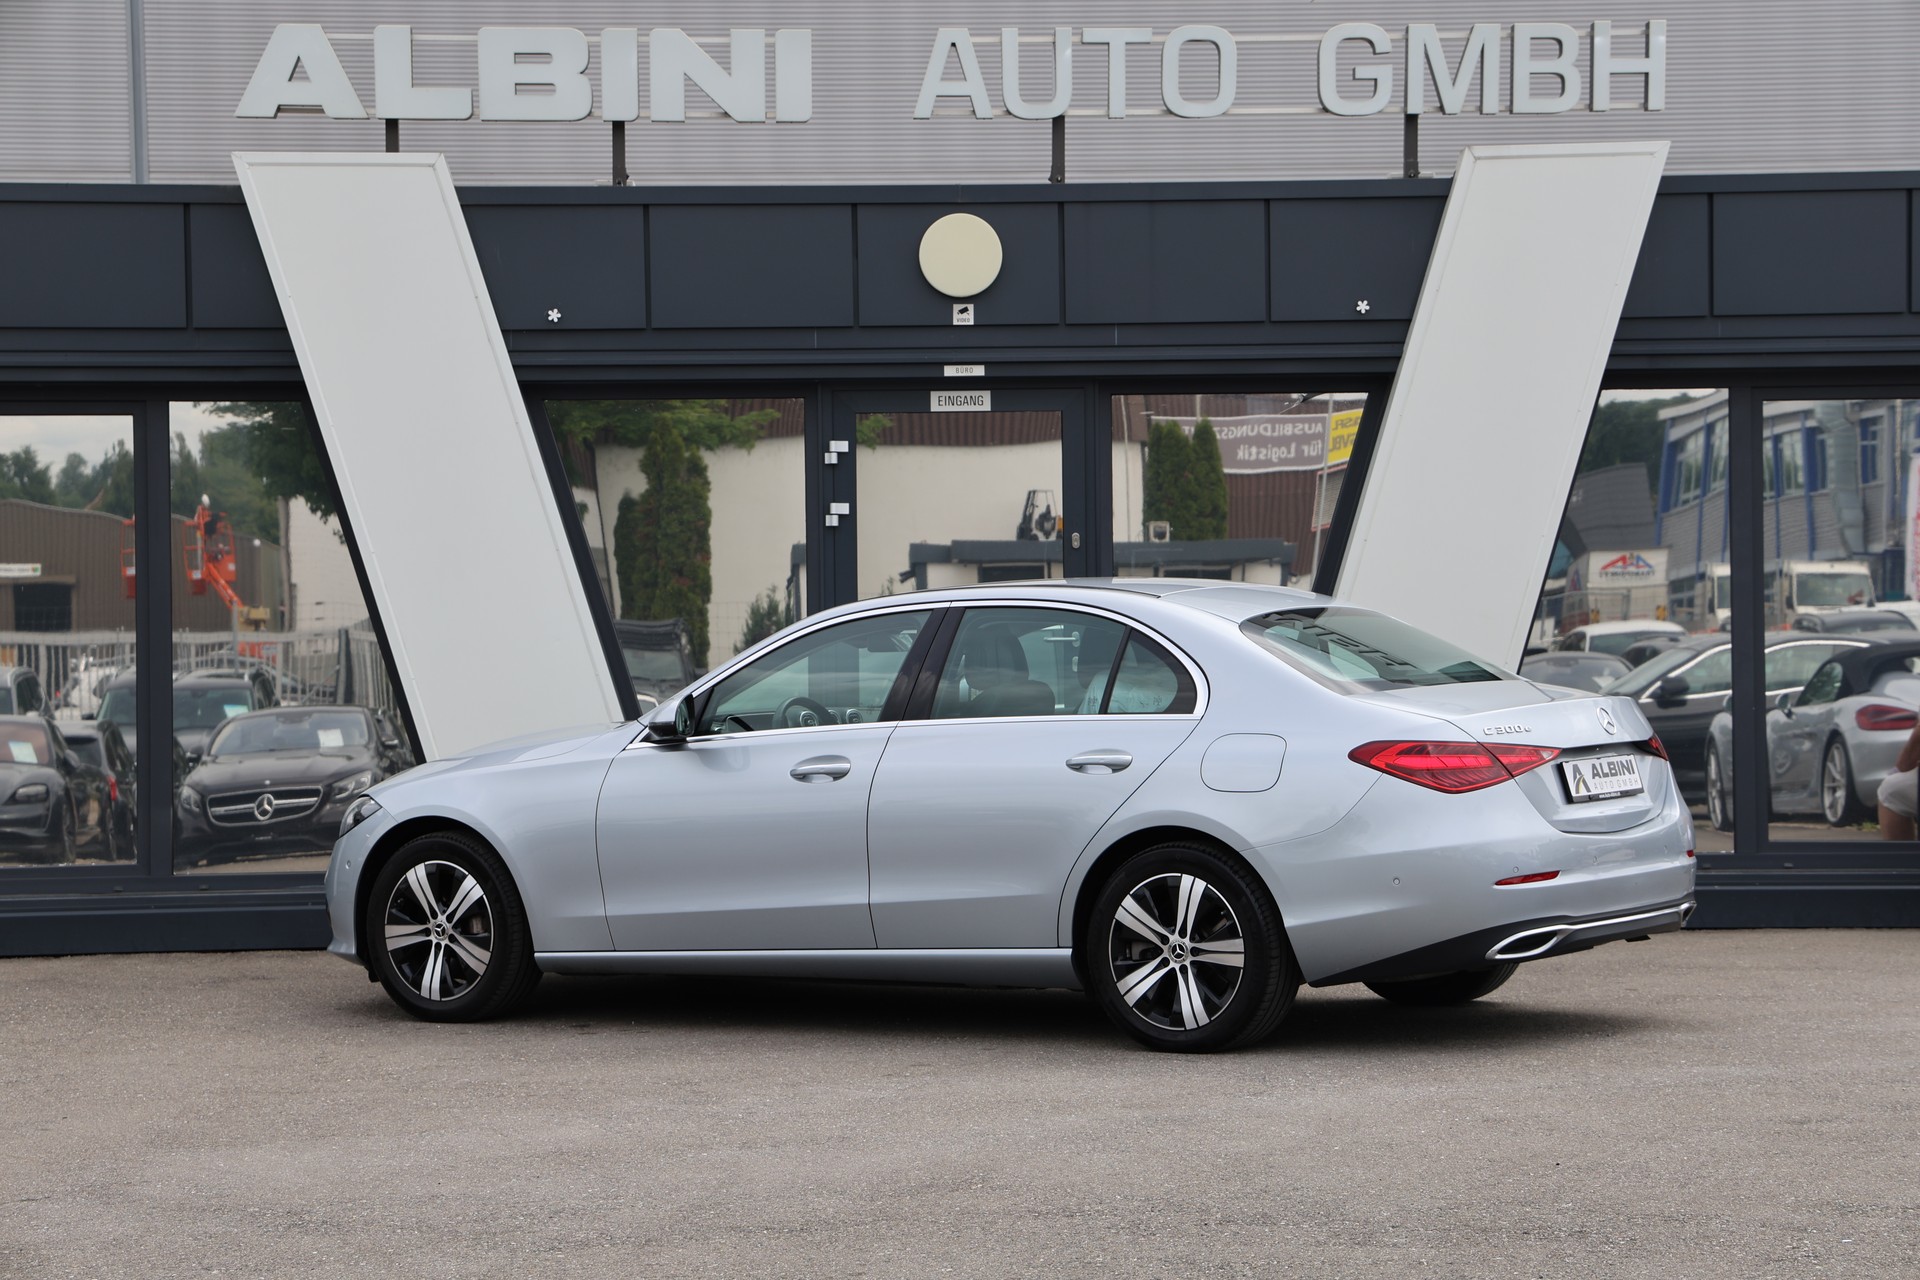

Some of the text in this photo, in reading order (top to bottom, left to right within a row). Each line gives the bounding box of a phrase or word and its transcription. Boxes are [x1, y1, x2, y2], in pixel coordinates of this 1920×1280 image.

[234, 19, 1667, 123] ALBINI AUTO GMBH
[955, 366, 974, 374] BÜRO
[937, 395, 984, 407] EINGANG
[1591, 759, 1636, 780] ALBINI
[1593, 777, 1640, 791] AUTO GMBH
